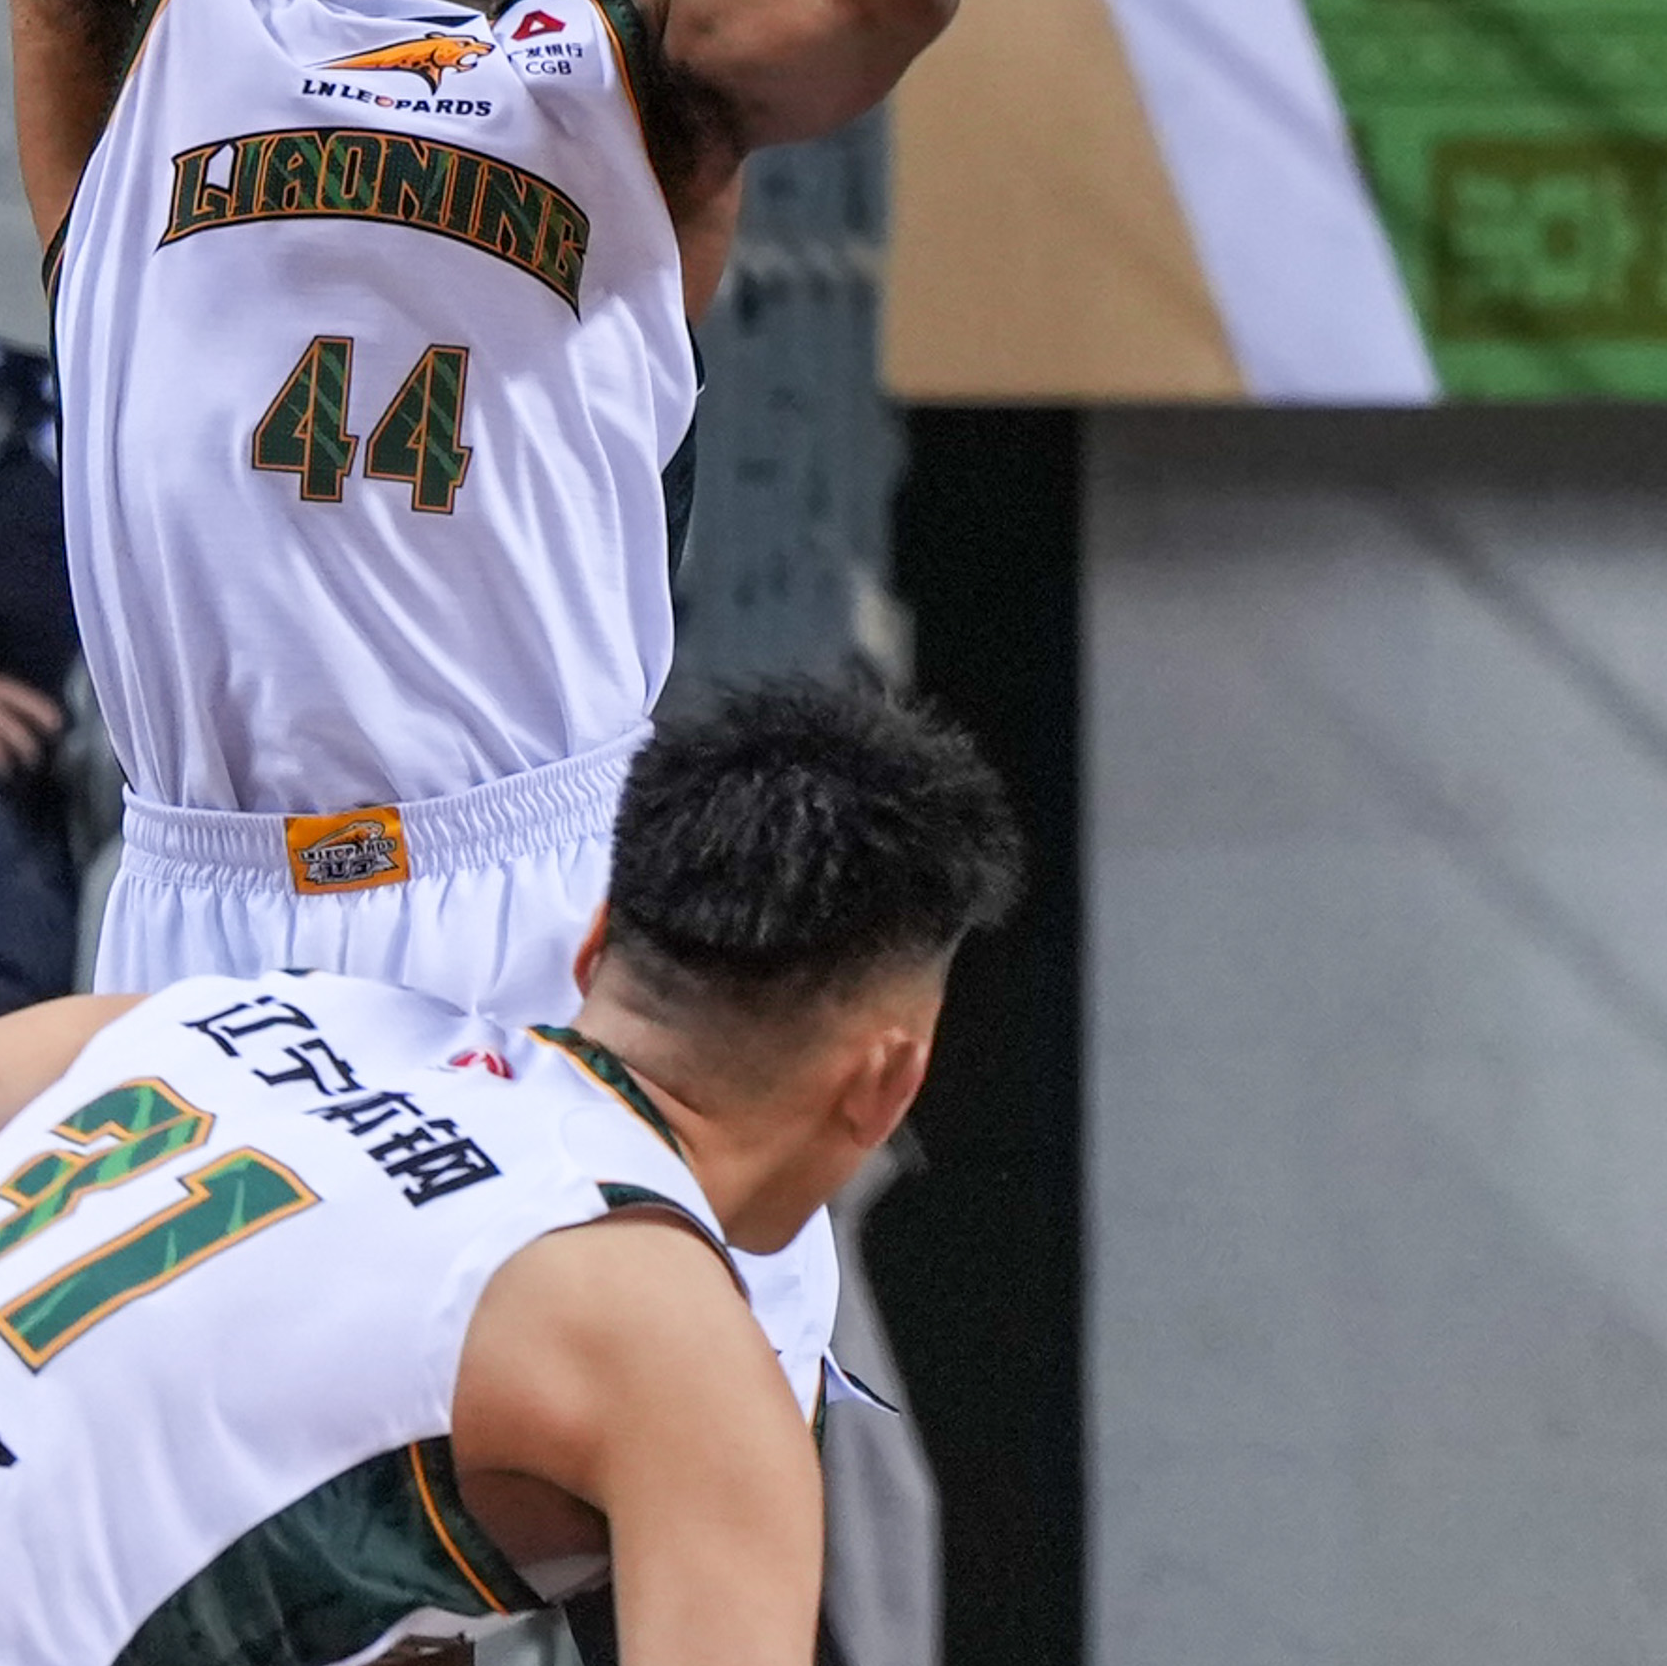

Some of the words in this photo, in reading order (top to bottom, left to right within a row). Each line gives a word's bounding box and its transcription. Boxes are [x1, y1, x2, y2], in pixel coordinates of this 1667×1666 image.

[525, 59, 572, 76] CGB
[154, 127, 590, 323] LIAONING
[251, 334, 473, 515] 44
[181, 995, 501, 1208] 辽宁本钢
